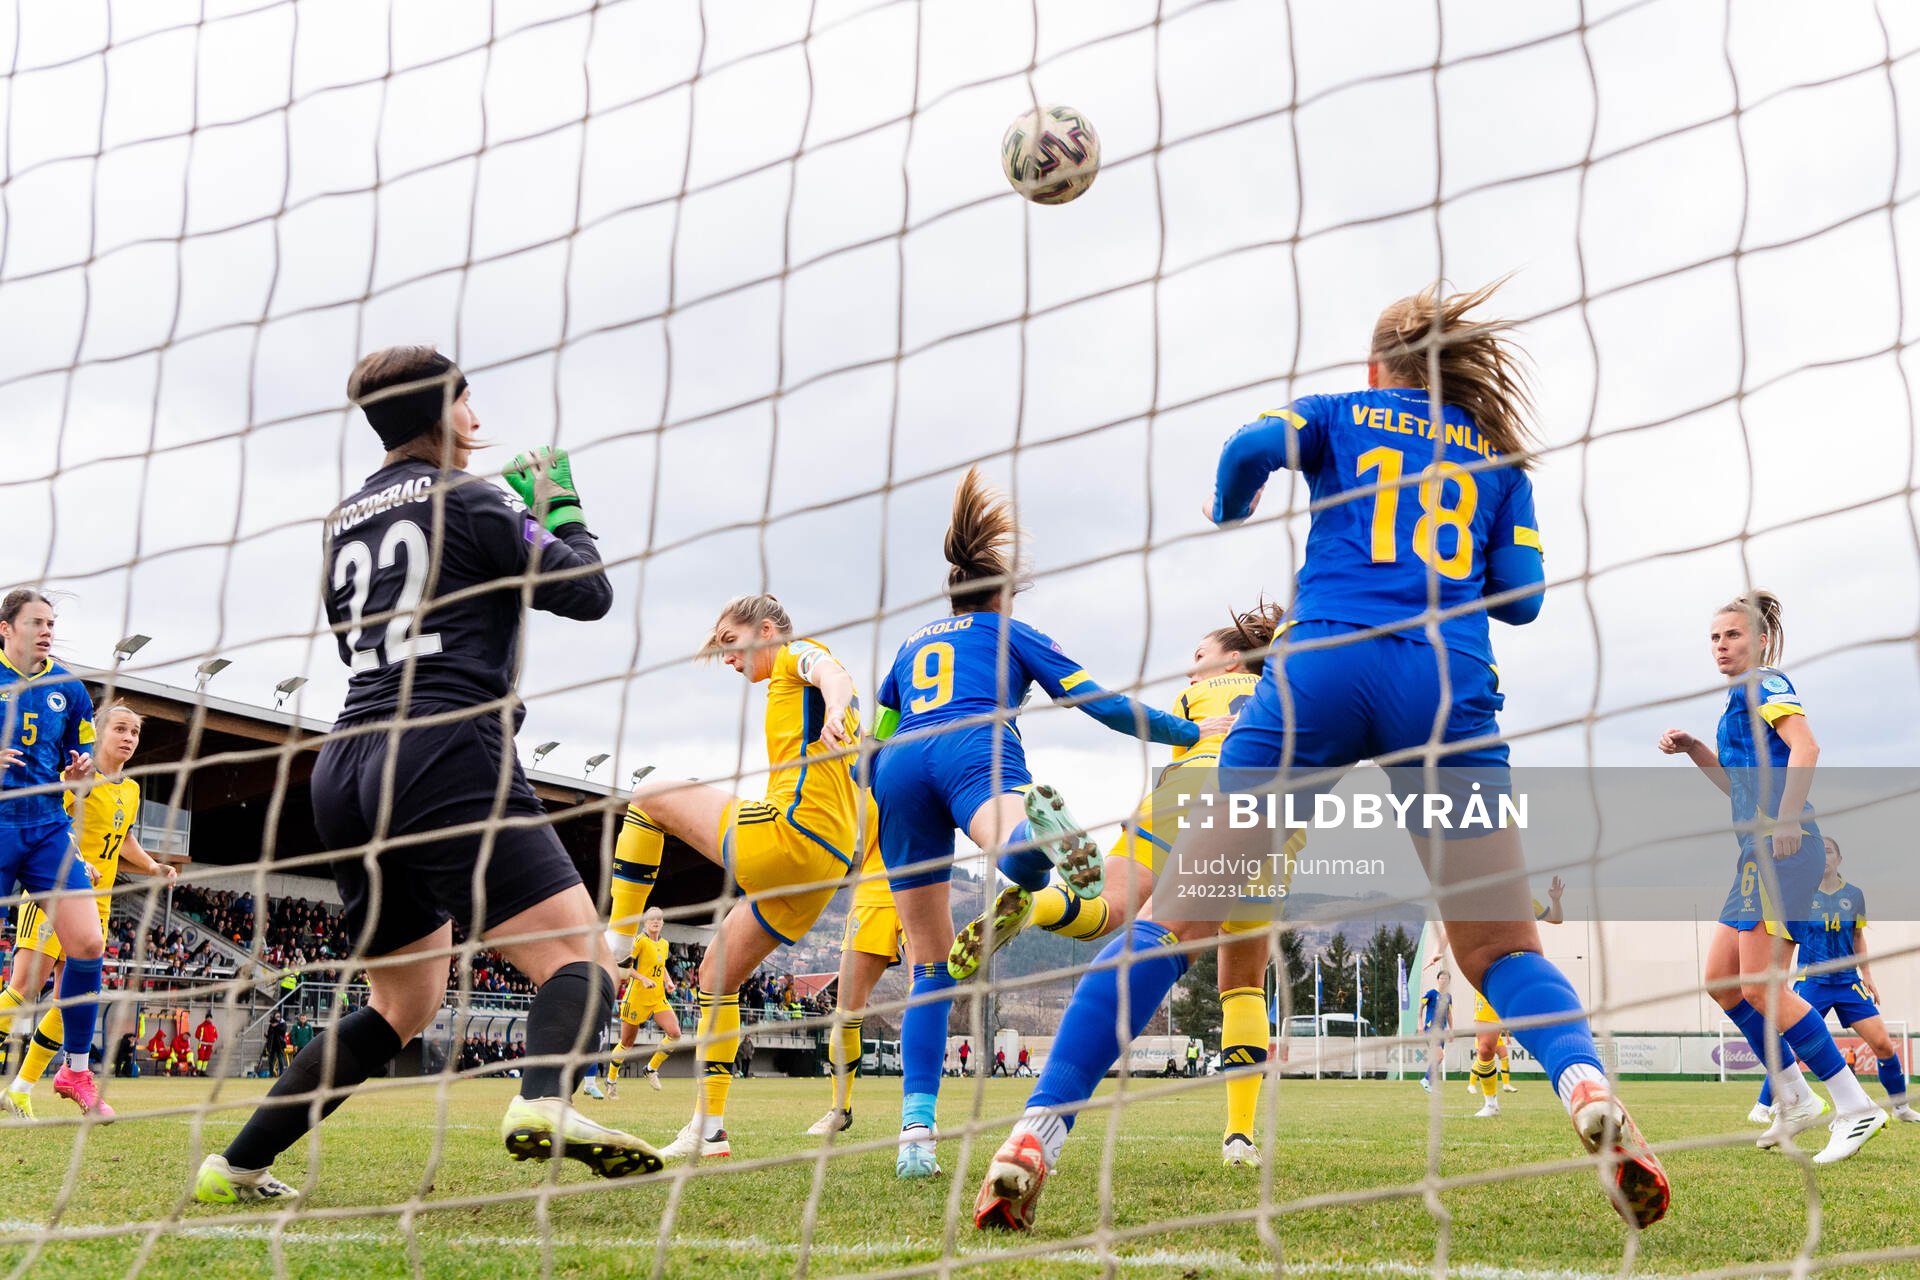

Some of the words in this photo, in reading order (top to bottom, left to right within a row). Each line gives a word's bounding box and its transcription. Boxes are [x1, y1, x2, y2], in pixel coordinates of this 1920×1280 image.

[1356, 446, 1478, 581] 18
[334, 519, 443, 677] 22
[911, 641, 955, 714] 9
[21, 712, 39, 746] 5
[99, 832, 122, 860] 17
[1741, 861, 1757, 897] 6
[1822, 912, 1841, 932] 14
[652, 965, 663, 977] 16
